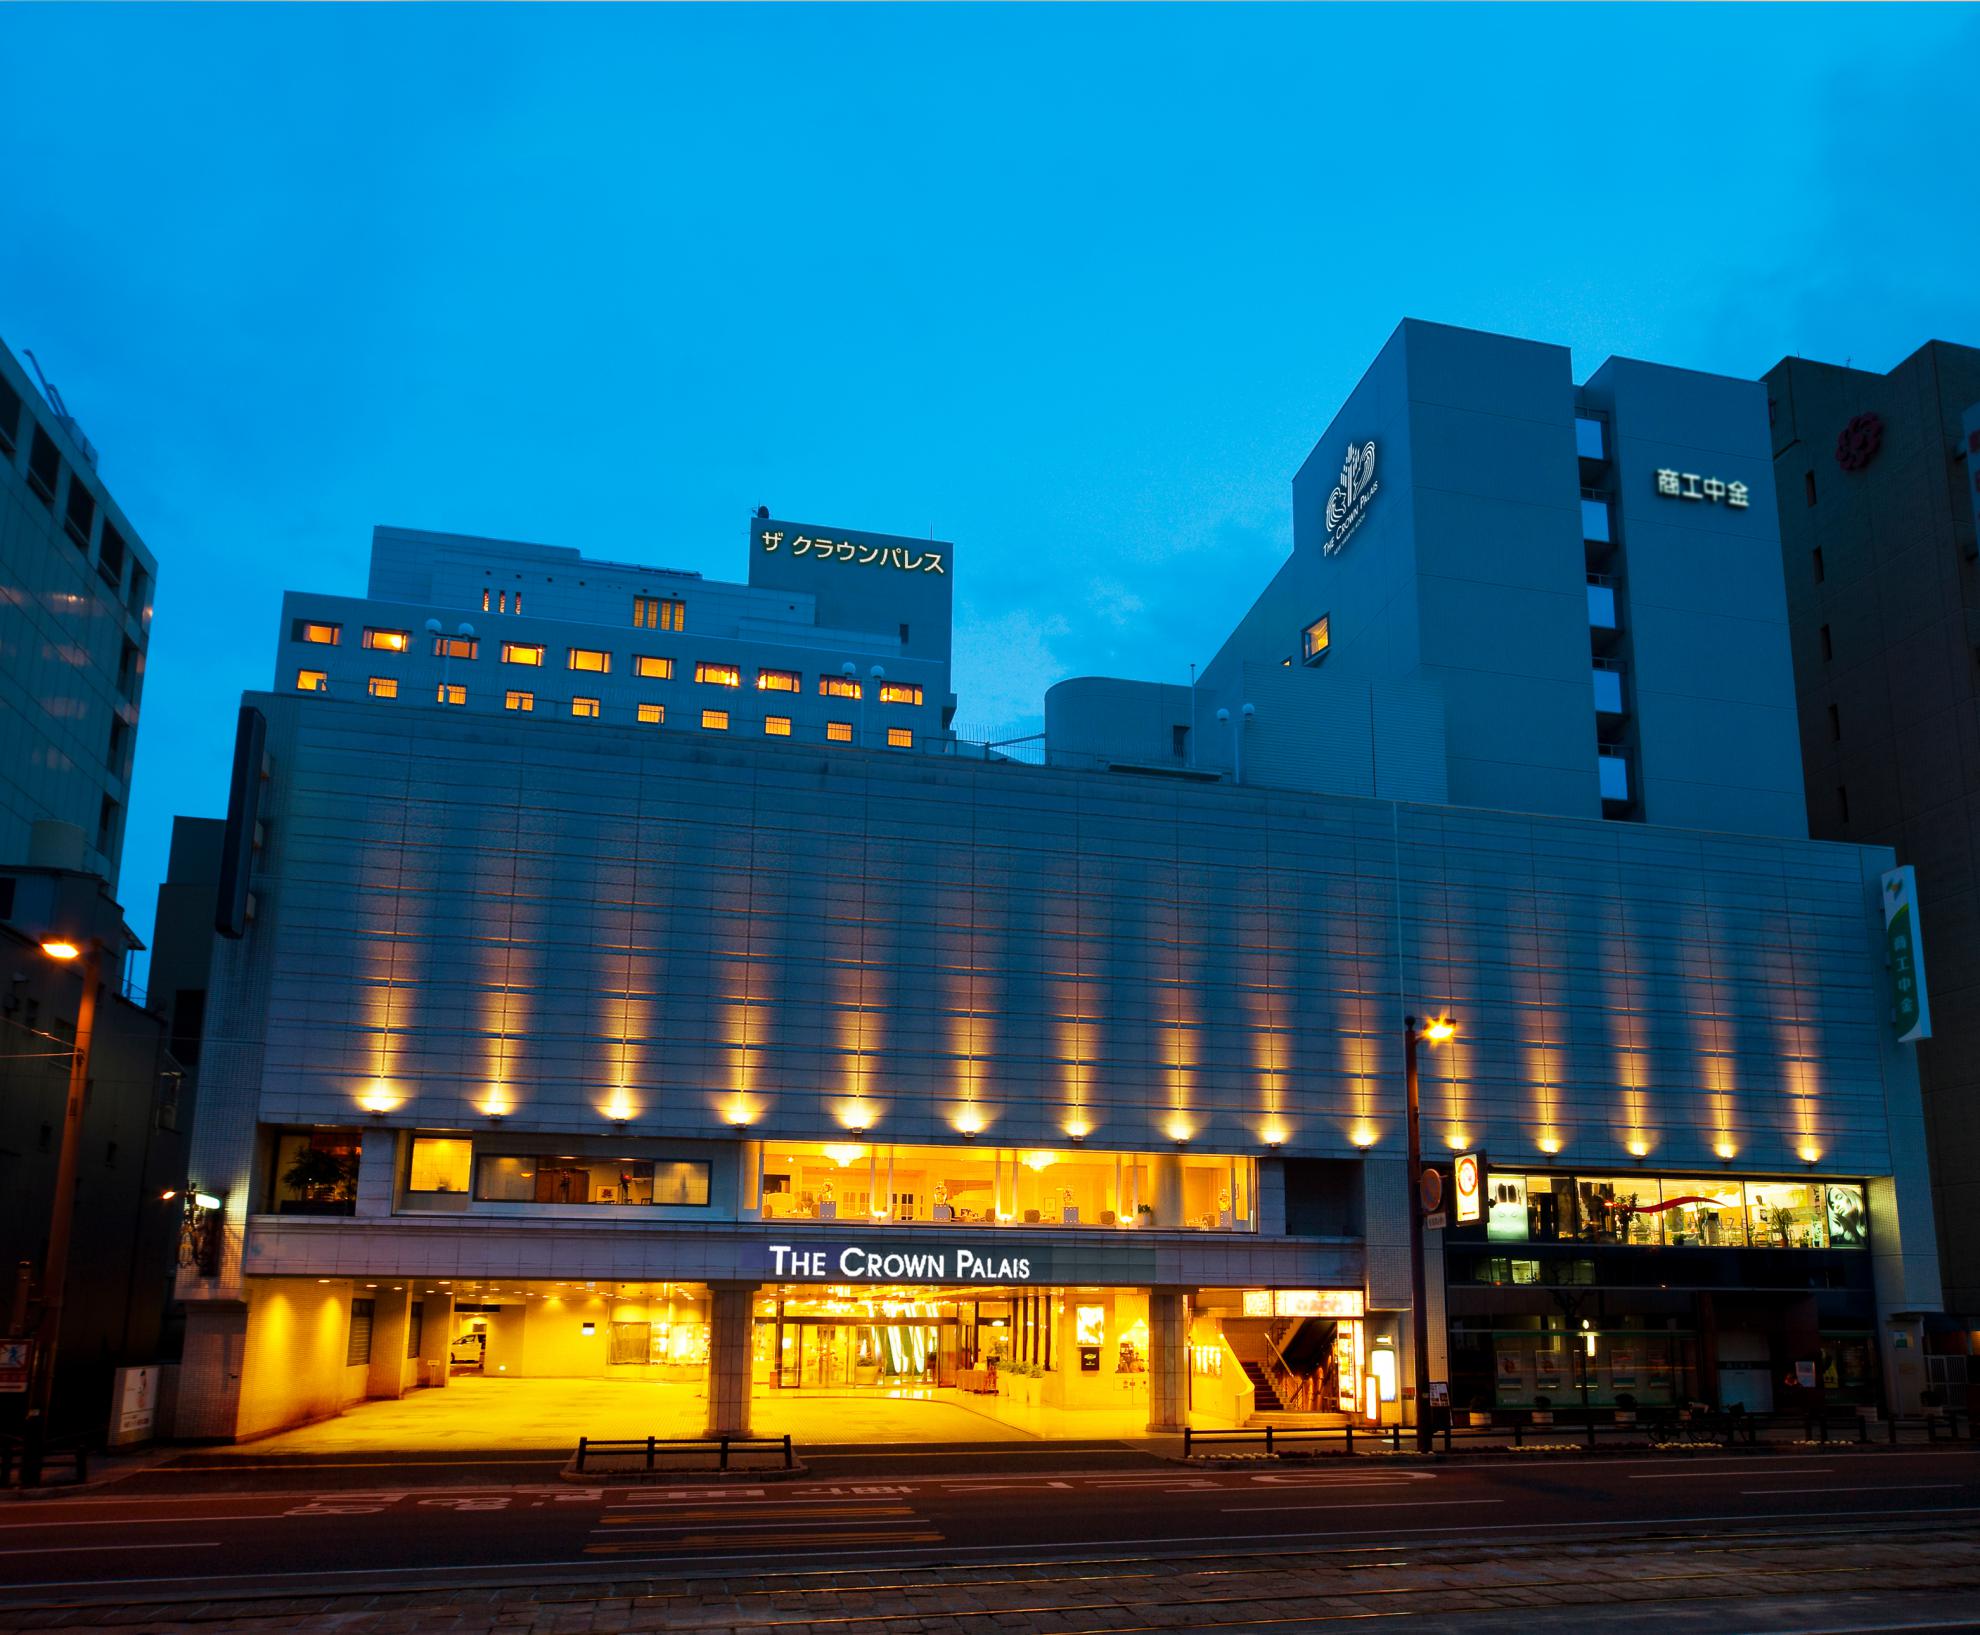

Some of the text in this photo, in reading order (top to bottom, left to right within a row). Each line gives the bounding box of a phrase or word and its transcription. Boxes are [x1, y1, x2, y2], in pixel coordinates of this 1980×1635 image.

[1658, 468, 1750, 506] 商工中金
[762, 532, 945, 574] ザ クラウンパレス
[769, 1245, 1031, 1279] THE CROWN PALAIS
